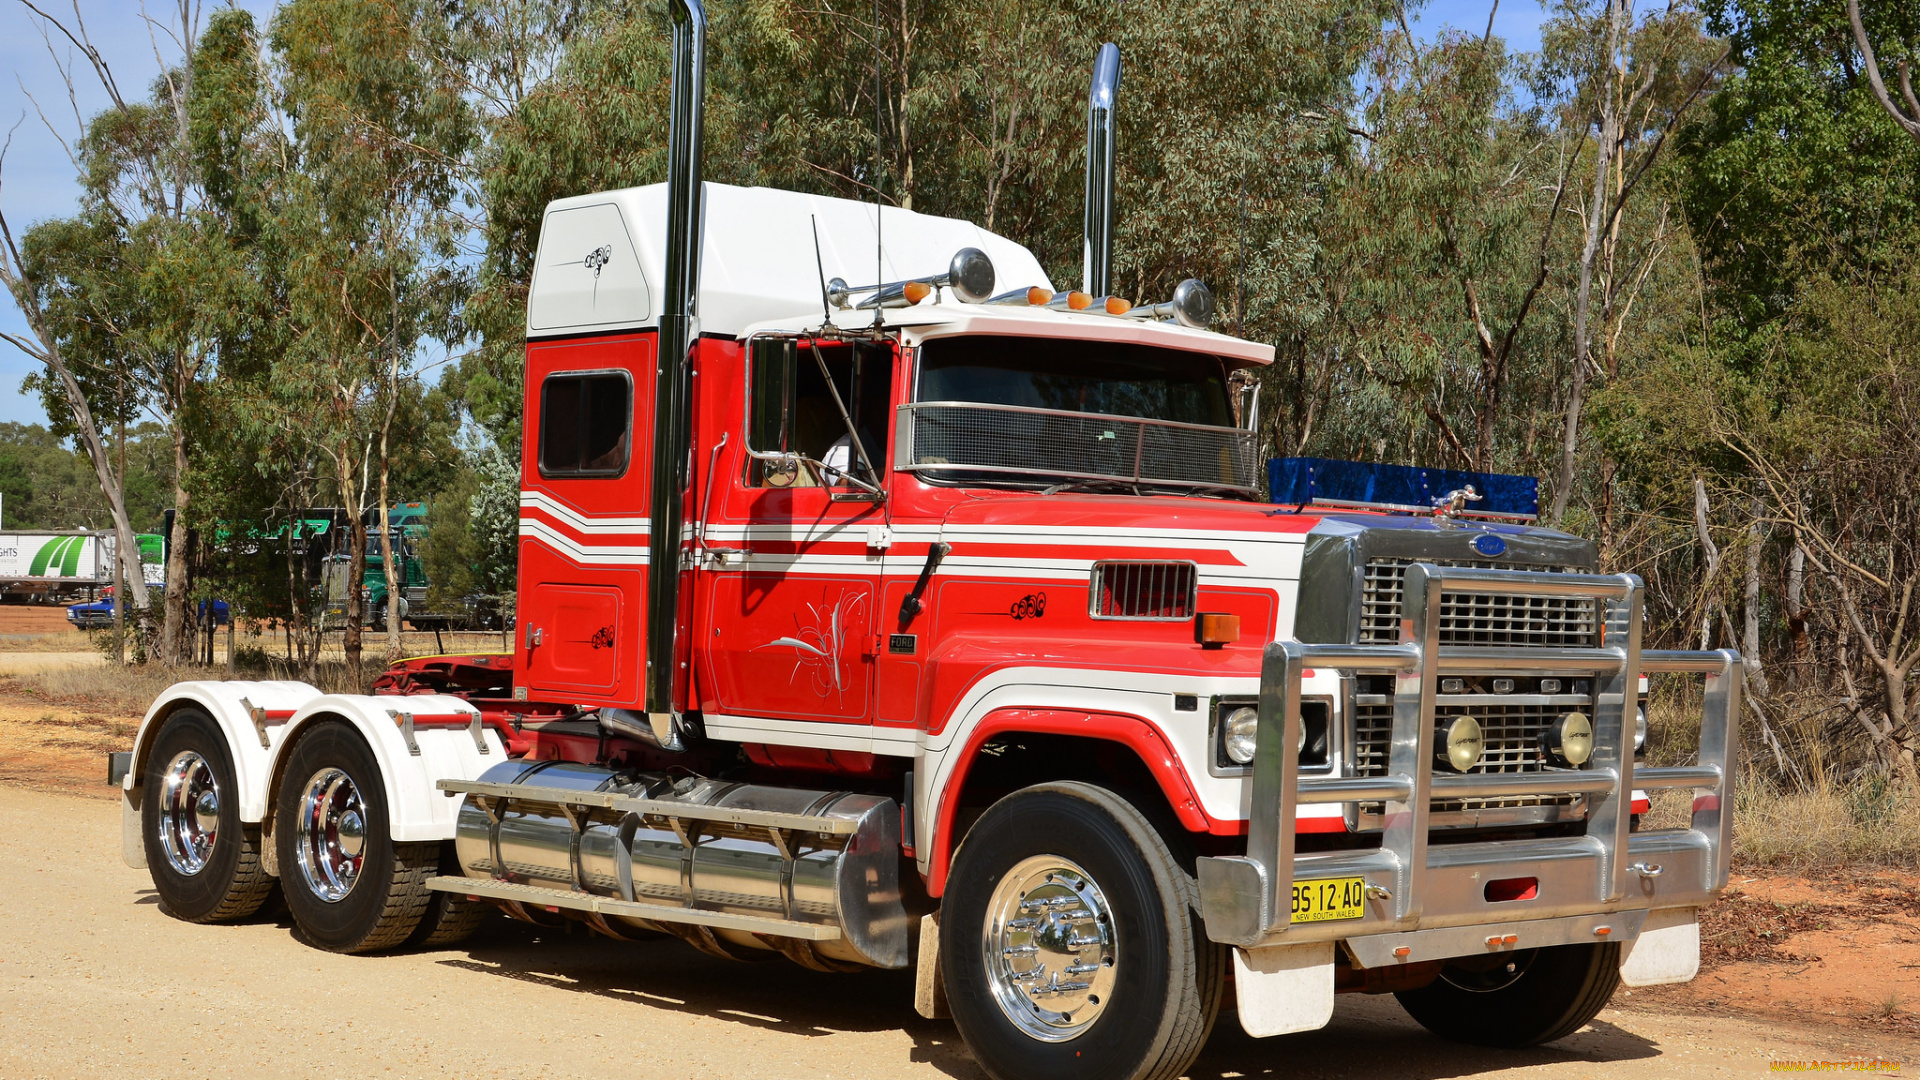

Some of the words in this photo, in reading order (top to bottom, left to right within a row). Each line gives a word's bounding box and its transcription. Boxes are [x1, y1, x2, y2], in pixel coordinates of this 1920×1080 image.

[891, 637, 913, 647] FORD
[1296, 913, 1310, 921] NEW
[1313, 911, 1333, 920] SOUTH
[1336, 909, 1356, 918] WALES
